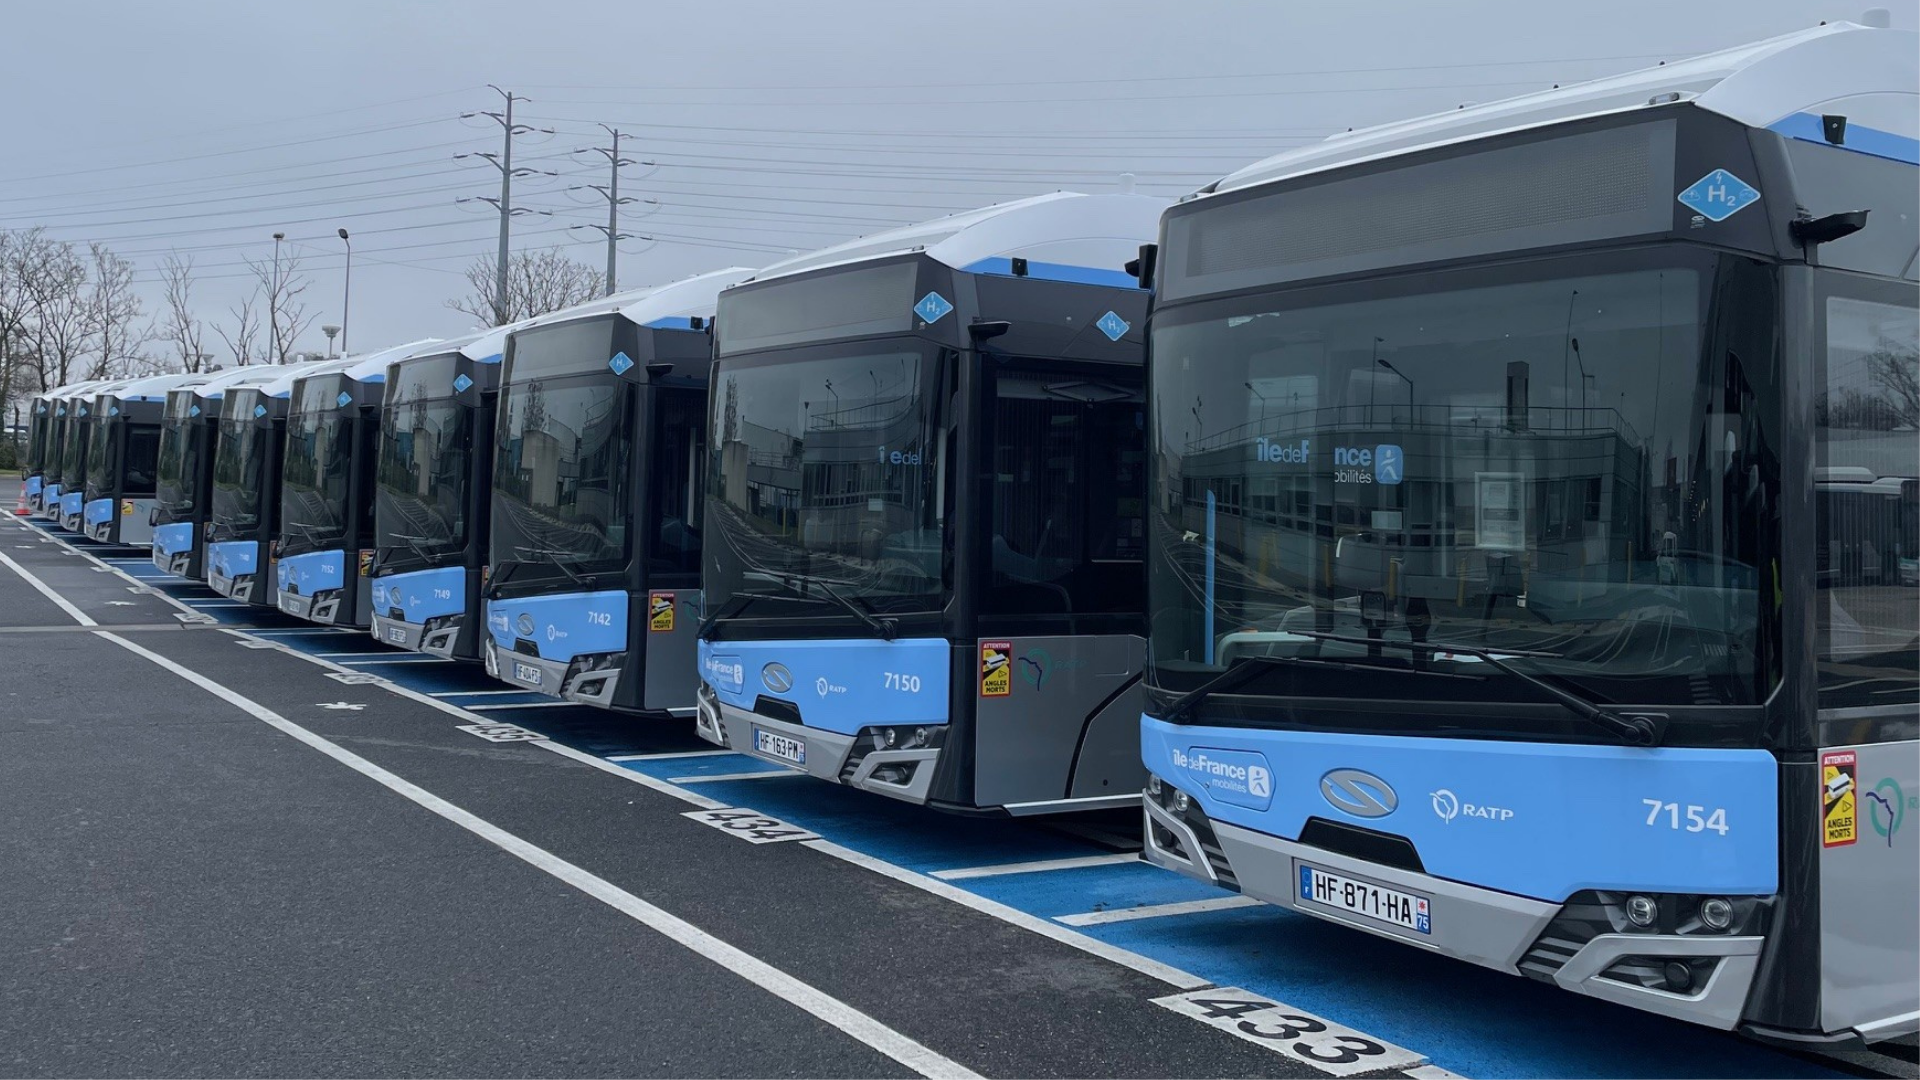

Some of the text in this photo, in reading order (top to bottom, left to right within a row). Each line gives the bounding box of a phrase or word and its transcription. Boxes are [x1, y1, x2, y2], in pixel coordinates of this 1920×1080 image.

[434, 589, 450, 599] 7149
[588, 611, 611, 626] 7142
[829, 684, 847, 693] RATP
[884, 671, 921, 693] 7150
[1824, 754, 1855, 765] ATTENTION
[1212, 777, 1247, 794] mobilités
[1463, 803, 1514, 821] RATP
[1642, 798, 1730, 836] 7154
[705, 812, 808, 840] 434
[1827, 816, 1853, 829] ANGLES
[1828, 828, 1851, 840] MORTS
[1315, 873, 1412, 924] HF-871-HA
[1418, 915, 1429, 930] 75
[1187, 998, 1387, 1064] 433
